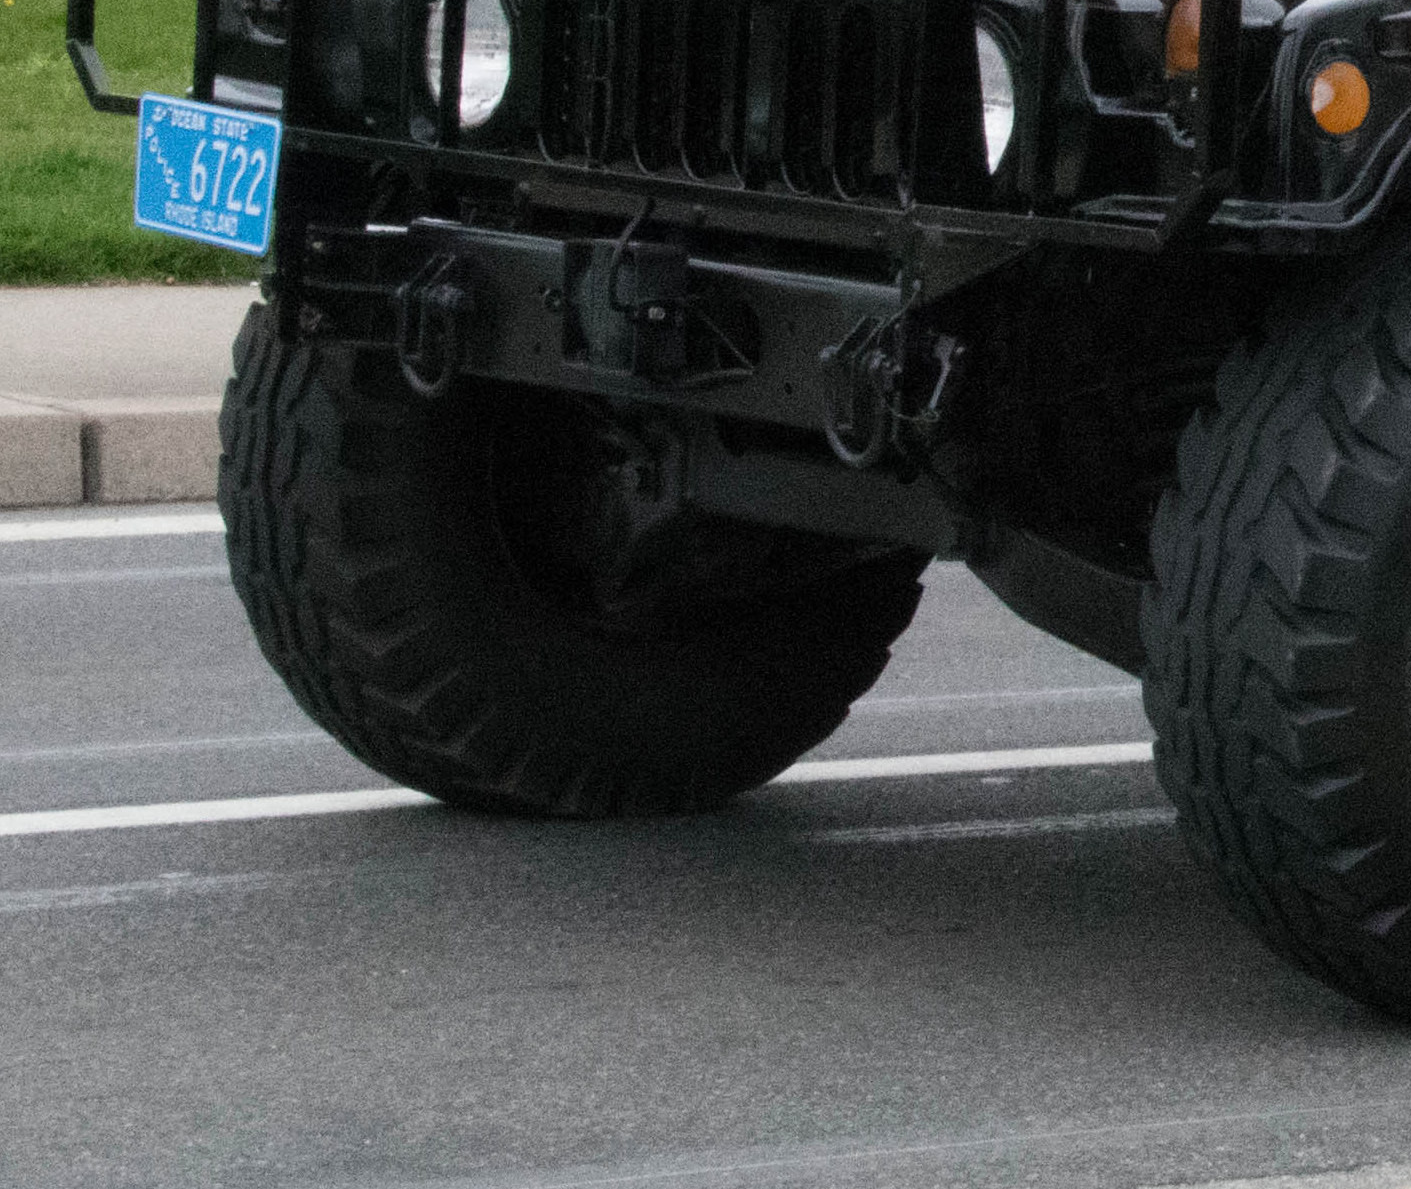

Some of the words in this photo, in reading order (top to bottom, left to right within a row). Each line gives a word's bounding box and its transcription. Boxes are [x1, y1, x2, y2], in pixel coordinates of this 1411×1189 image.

[145, 125, 181, 200] POLICE
[190, 138, 267, 216] 6722
[165, 201, 199, 228] RHODE
[201, 209, 238, 237] ISLAND
